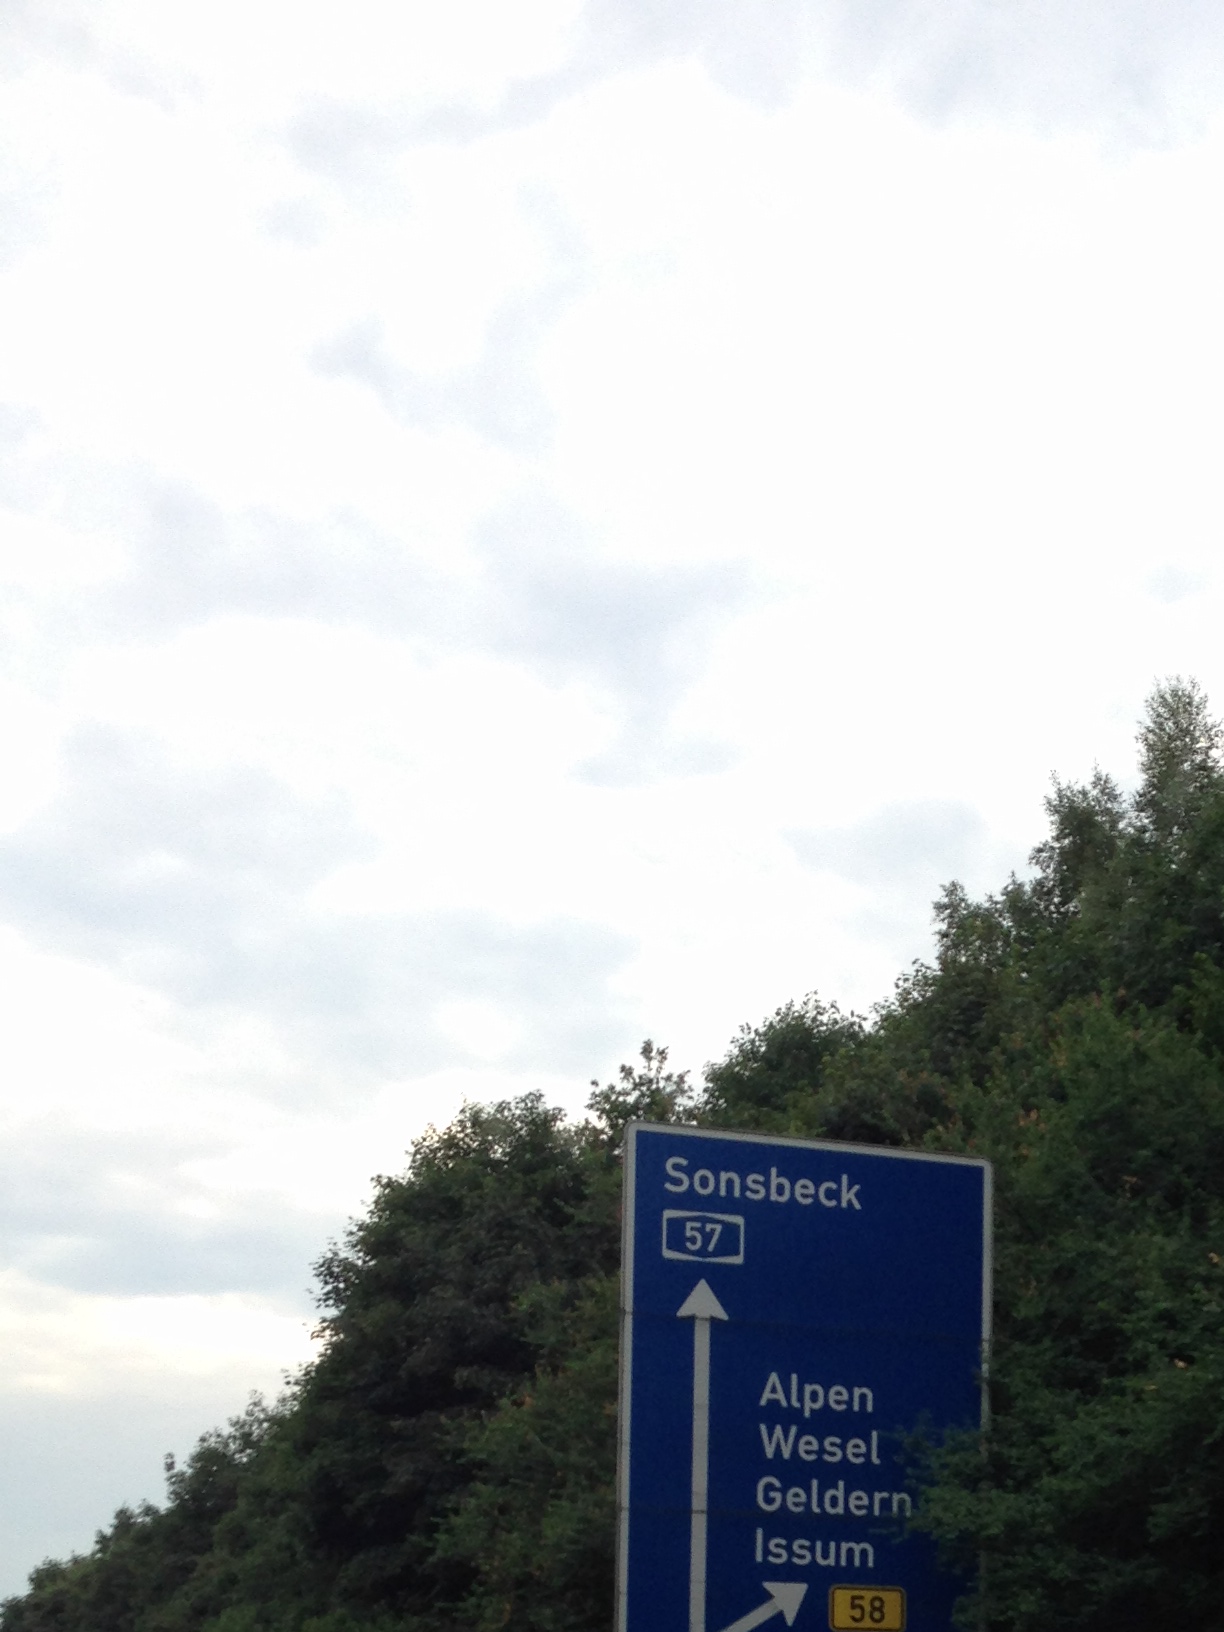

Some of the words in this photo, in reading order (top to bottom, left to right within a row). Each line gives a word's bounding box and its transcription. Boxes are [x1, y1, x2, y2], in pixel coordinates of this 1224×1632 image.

[664, 1156, 862, 1210] Sonsbeck
[684, 1221, 723, 1252] 57
[759, 1371, 874, 1418] Alpen
[759, 1424, 881, 1465] Wesel
[755, 1475, 912, 1517] Geldern
[755, 1527, 875, 1568] Issum
[849, 1595, 886, 1624] 58
